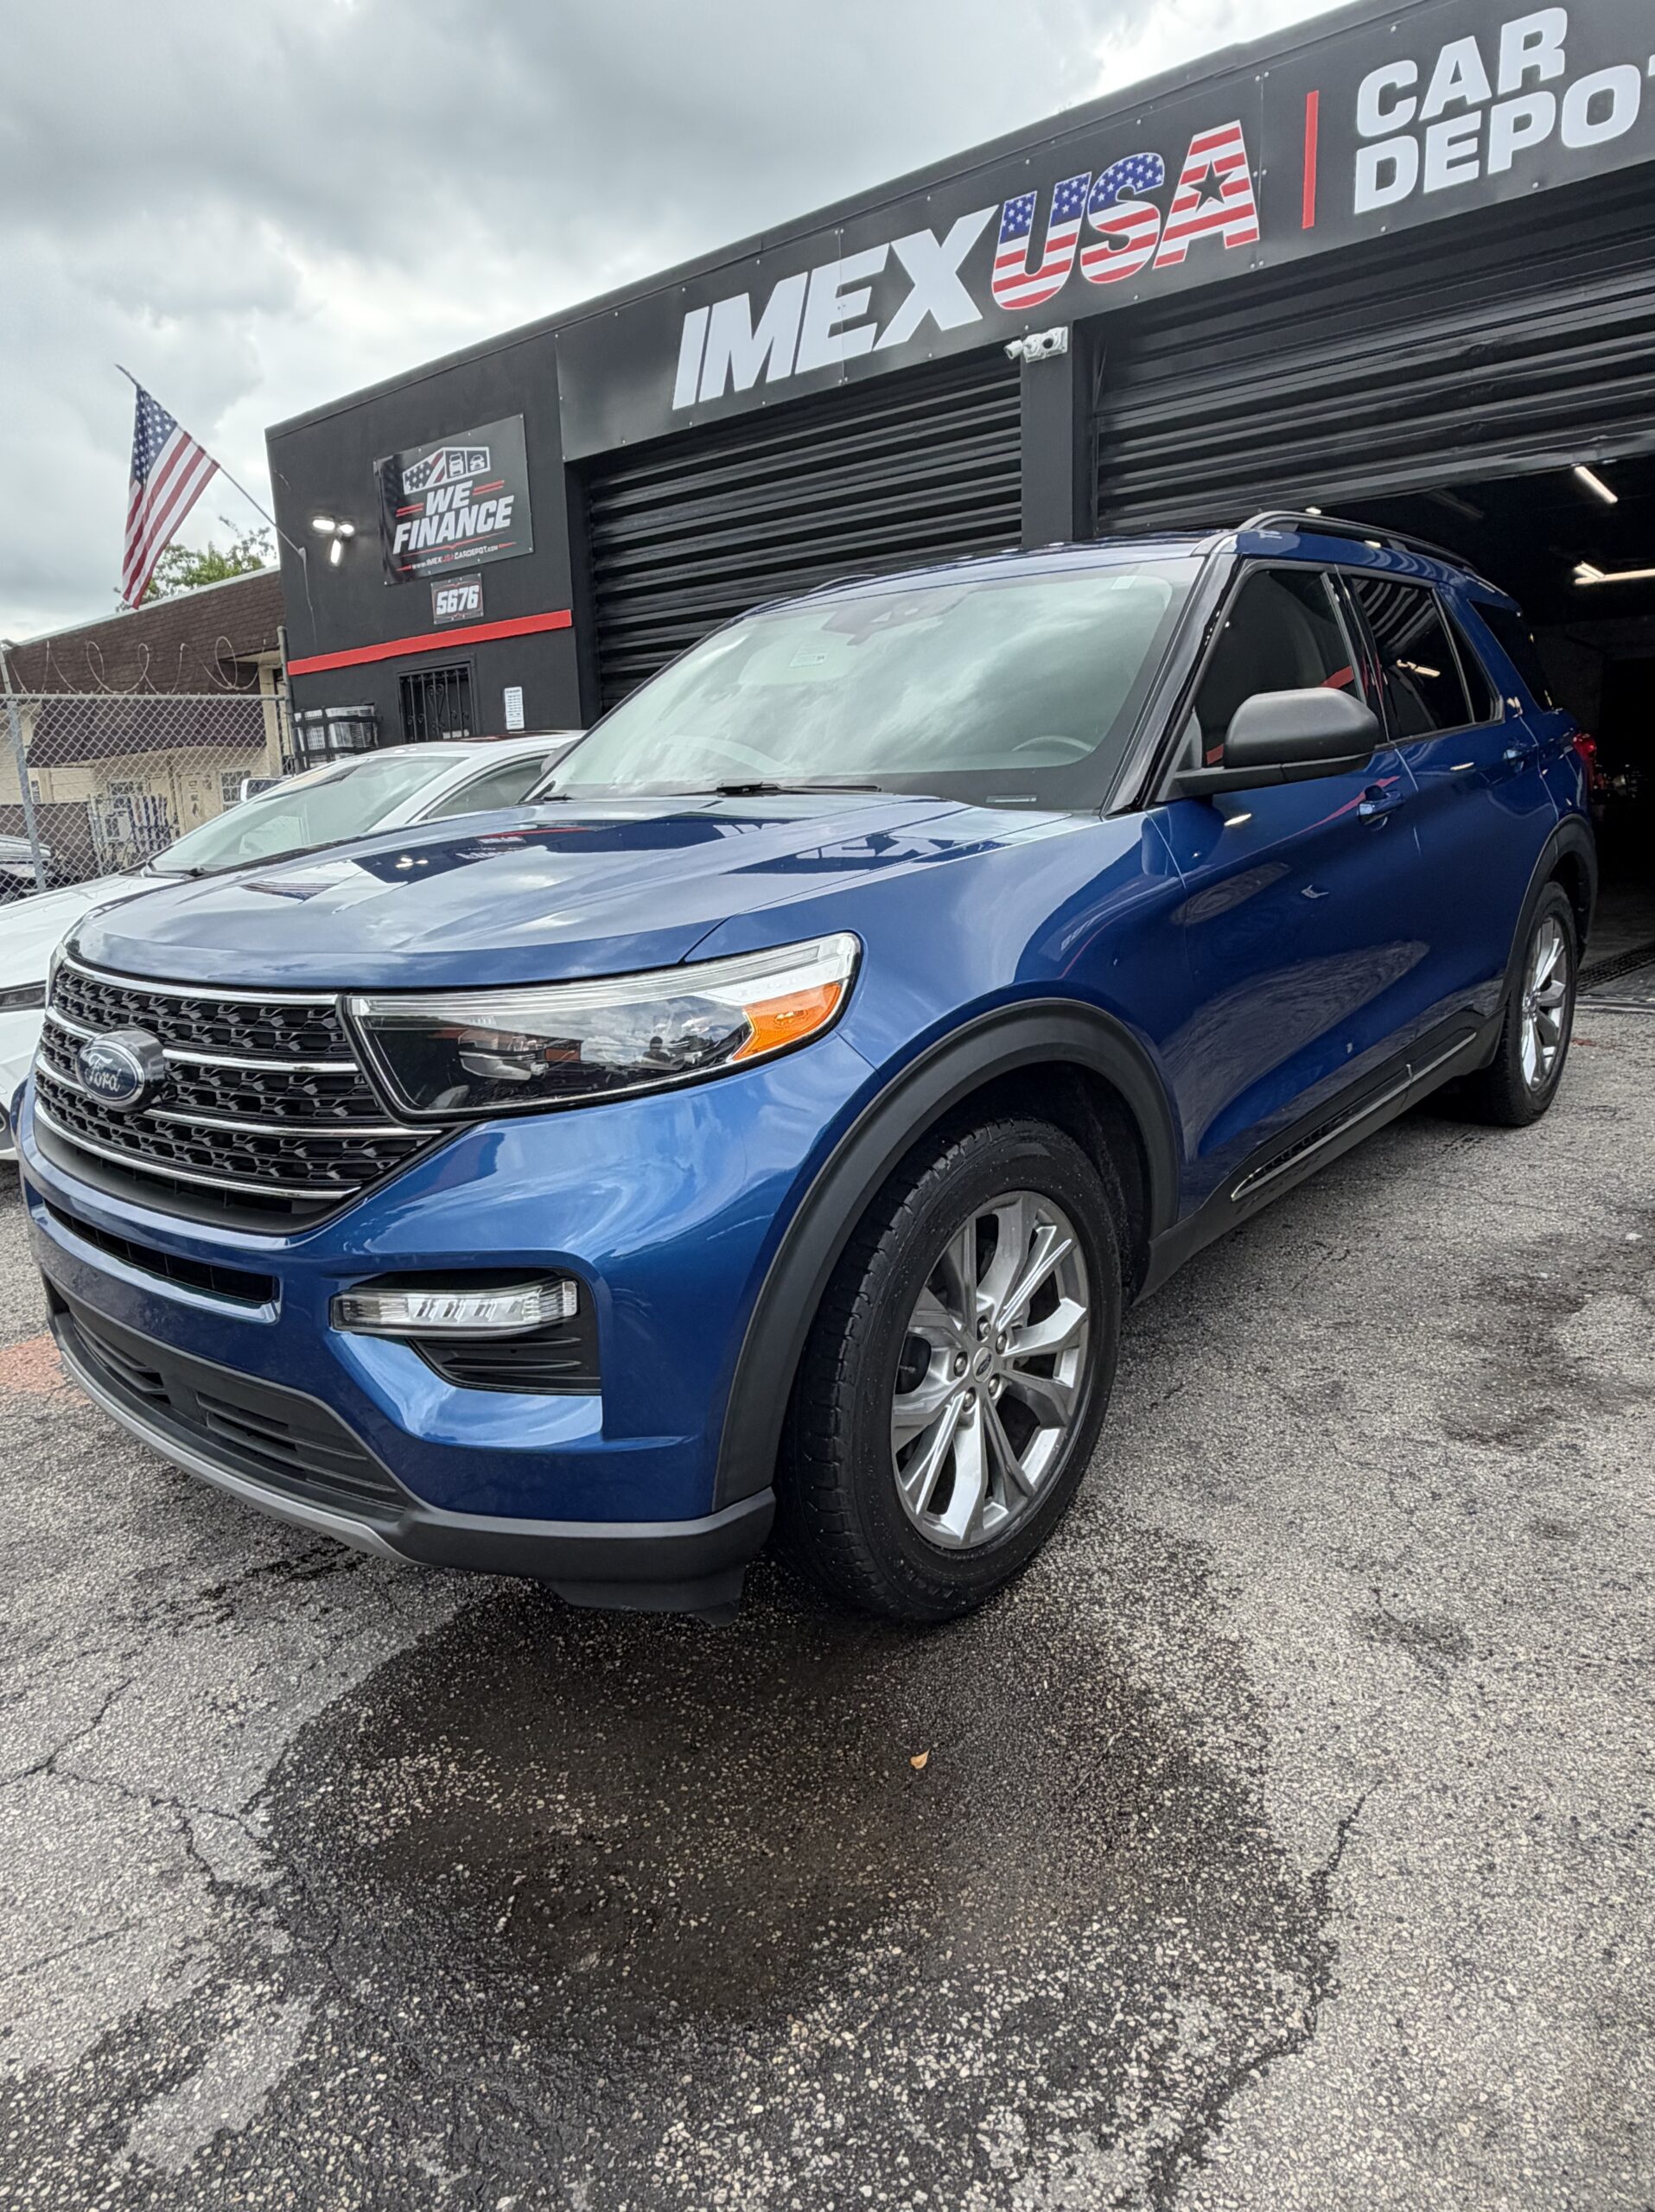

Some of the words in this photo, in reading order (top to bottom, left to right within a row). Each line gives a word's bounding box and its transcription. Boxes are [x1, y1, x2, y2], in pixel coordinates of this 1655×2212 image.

[1357, 7, 1568, 137] CAR
[1354, 57, 1655, 214] DEPO
[426, 480, 473, 516] WE
[393, 495, 514, 555] FINANCE
[436, 585, 479, 614] 5676
[85, 1053, 122, 1092] Ford
